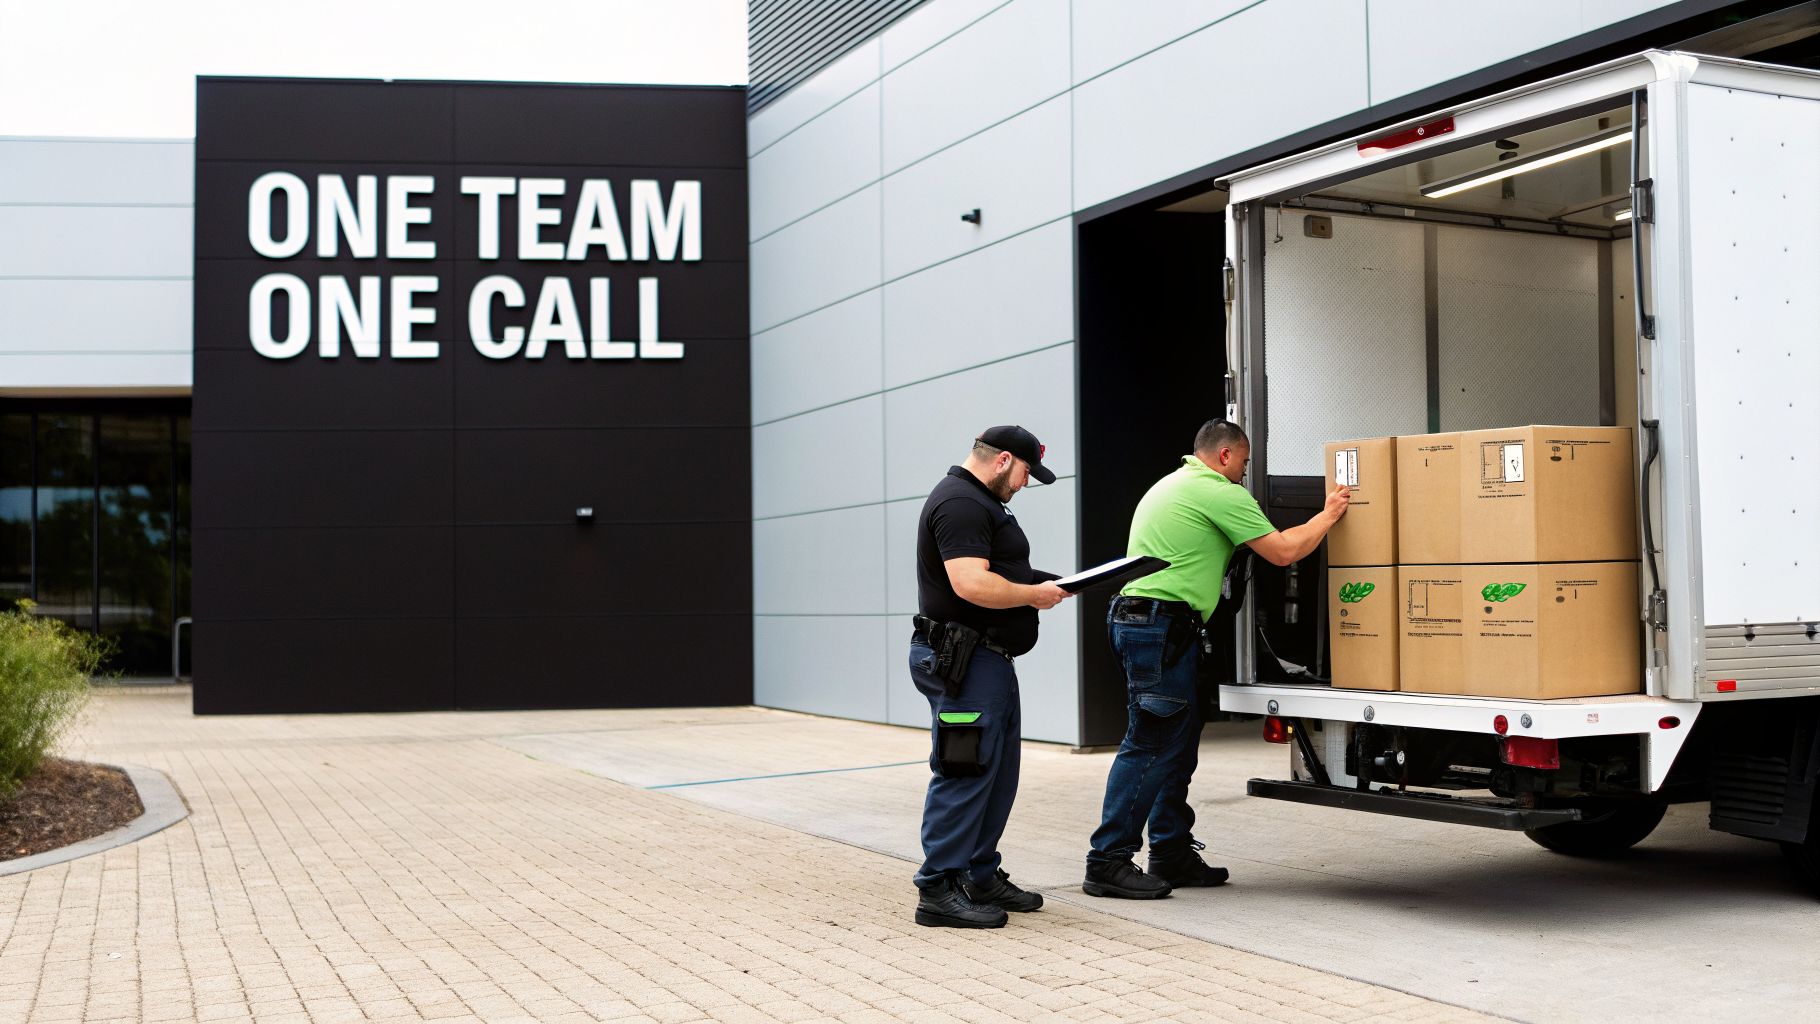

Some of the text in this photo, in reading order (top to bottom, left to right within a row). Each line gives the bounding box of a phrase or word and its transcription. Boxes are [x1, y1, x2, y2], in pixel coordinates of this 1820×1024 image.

[248, 172, 702, 261] ONE TEAM
[249, 273, 684, 359] ONE CALL
